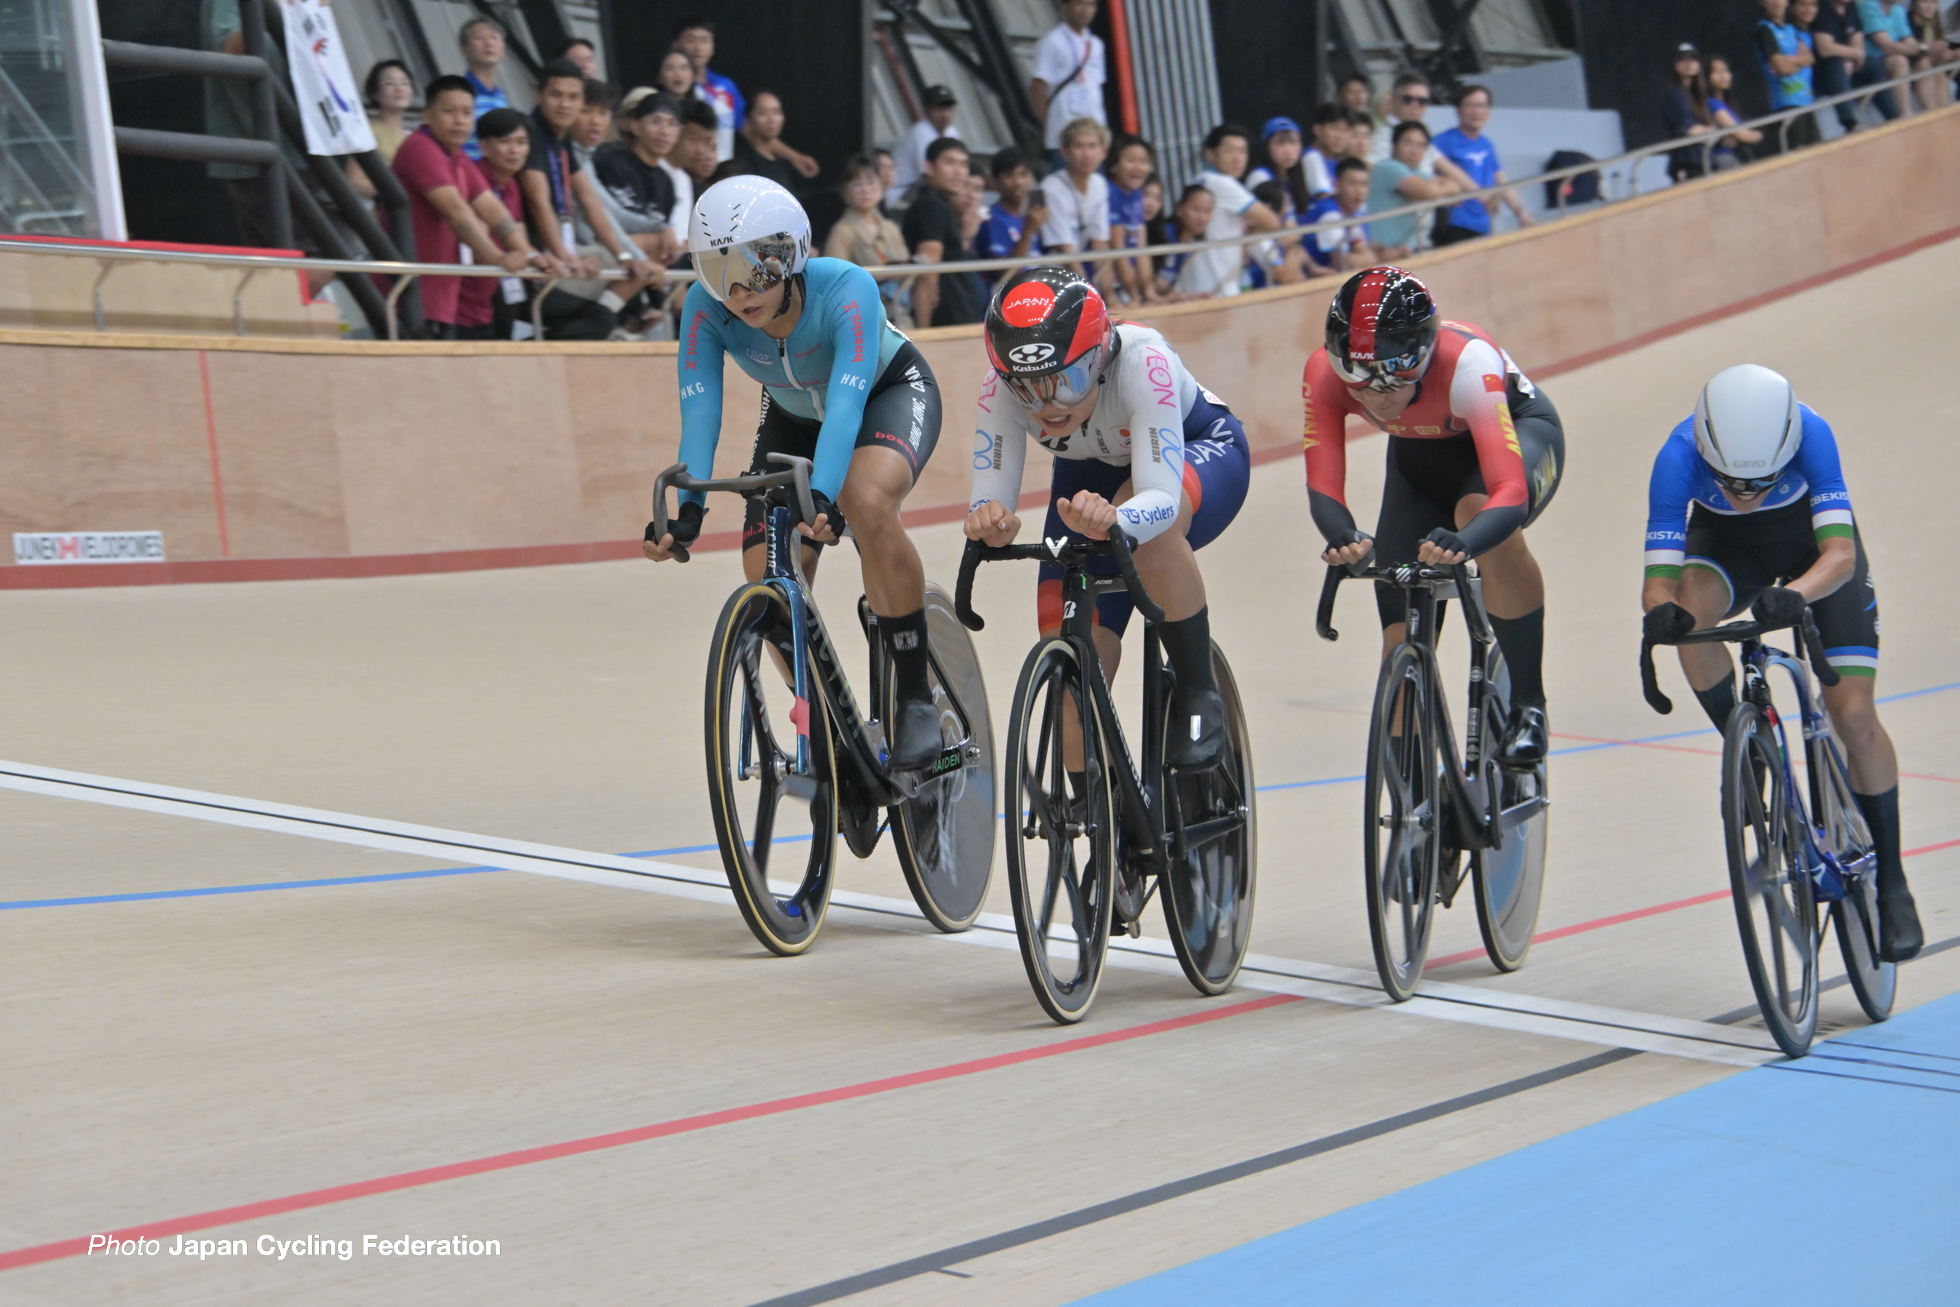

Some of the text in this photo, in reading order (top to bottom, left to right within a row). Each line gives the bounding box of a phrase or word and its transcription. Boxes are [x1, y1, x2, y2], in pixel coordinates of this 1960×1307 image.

[710, 236, 734, 247] KASK
[1006, 297, 1050, 309] JAPAN
[843, 299, 864, 363] bossini.X
[685, 310, 709, 371] bossini.X
[1350, 351, 1374, 360] KASK
[1012, 360, 1057, 373] Kabuto
[680, 382, 705, 400] HKG
[840, 373, 867, 391] HKG
[993, 434, 1004, 471] KEIRIN
[1149, 427, 1161, 464] KEIRIN
[1732, 460, 1766, 468] GIRO
[1140, 505, 1175, 526] Cyclers
[767, 515, 777, 569] FACTOR
